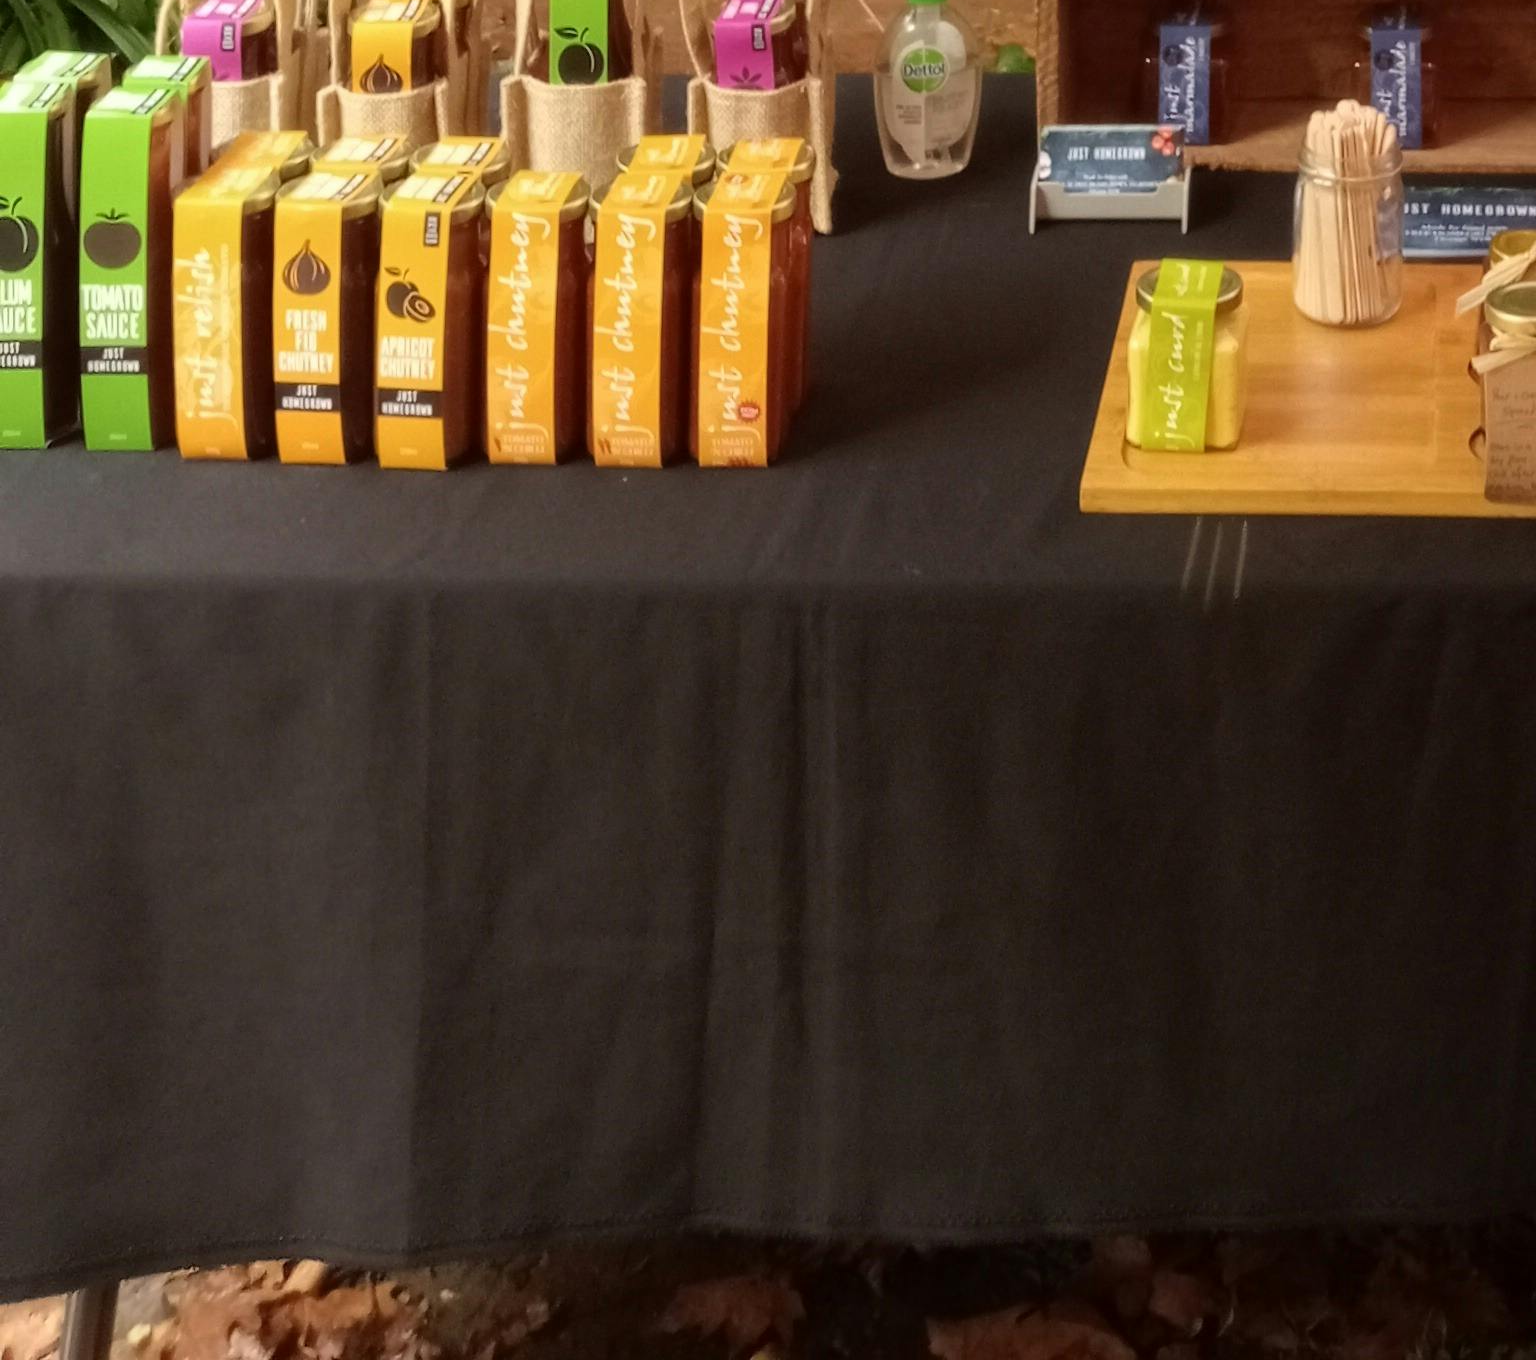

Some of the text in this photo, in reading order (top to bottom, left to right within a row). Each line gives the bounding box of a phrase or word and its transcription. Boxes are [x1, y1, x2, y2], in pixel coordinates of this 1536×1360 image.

[903, 63, 945, 77] Dettol
[1177, 36, 1196, 133] marmalade
[1389, 40, 1408, 136] marmalade
[1067, 146, 1146, 161] JUST HOMEGROWN
[0, 278, 32, 306] LUM
[82, 283, 143, 312] TOMATO
[86, 311, 140, 340] SAUCE
[284, 308, 328, 332] FRESH
[487, 211, 551, 438] just chutney
[593, 212, 657, 441] just chutney
[700, 212, 764, 441] just chutney
[174, 246, 239, 431] just relish
[294, 331, 318, 353] FIG
[380, 334, 436, 359] APRICOT
[1161, 311, 1186, 373] curd
[103, 346, 124, 360] JUST
[278, 350, 334, 374] CHUTNEY
[87, 360, 141, 373] HOMEGROWN
[379, 356, 436, 381] CHUTNEY
[296, 384, 318, 396] JUST
[396, 390, 418, 402] JUST
[281, 395, 333, 411] HOMEGROWN
[381, 401, 433, 416] HOMEGROWN
[1153, 382, 1196, 448] just
